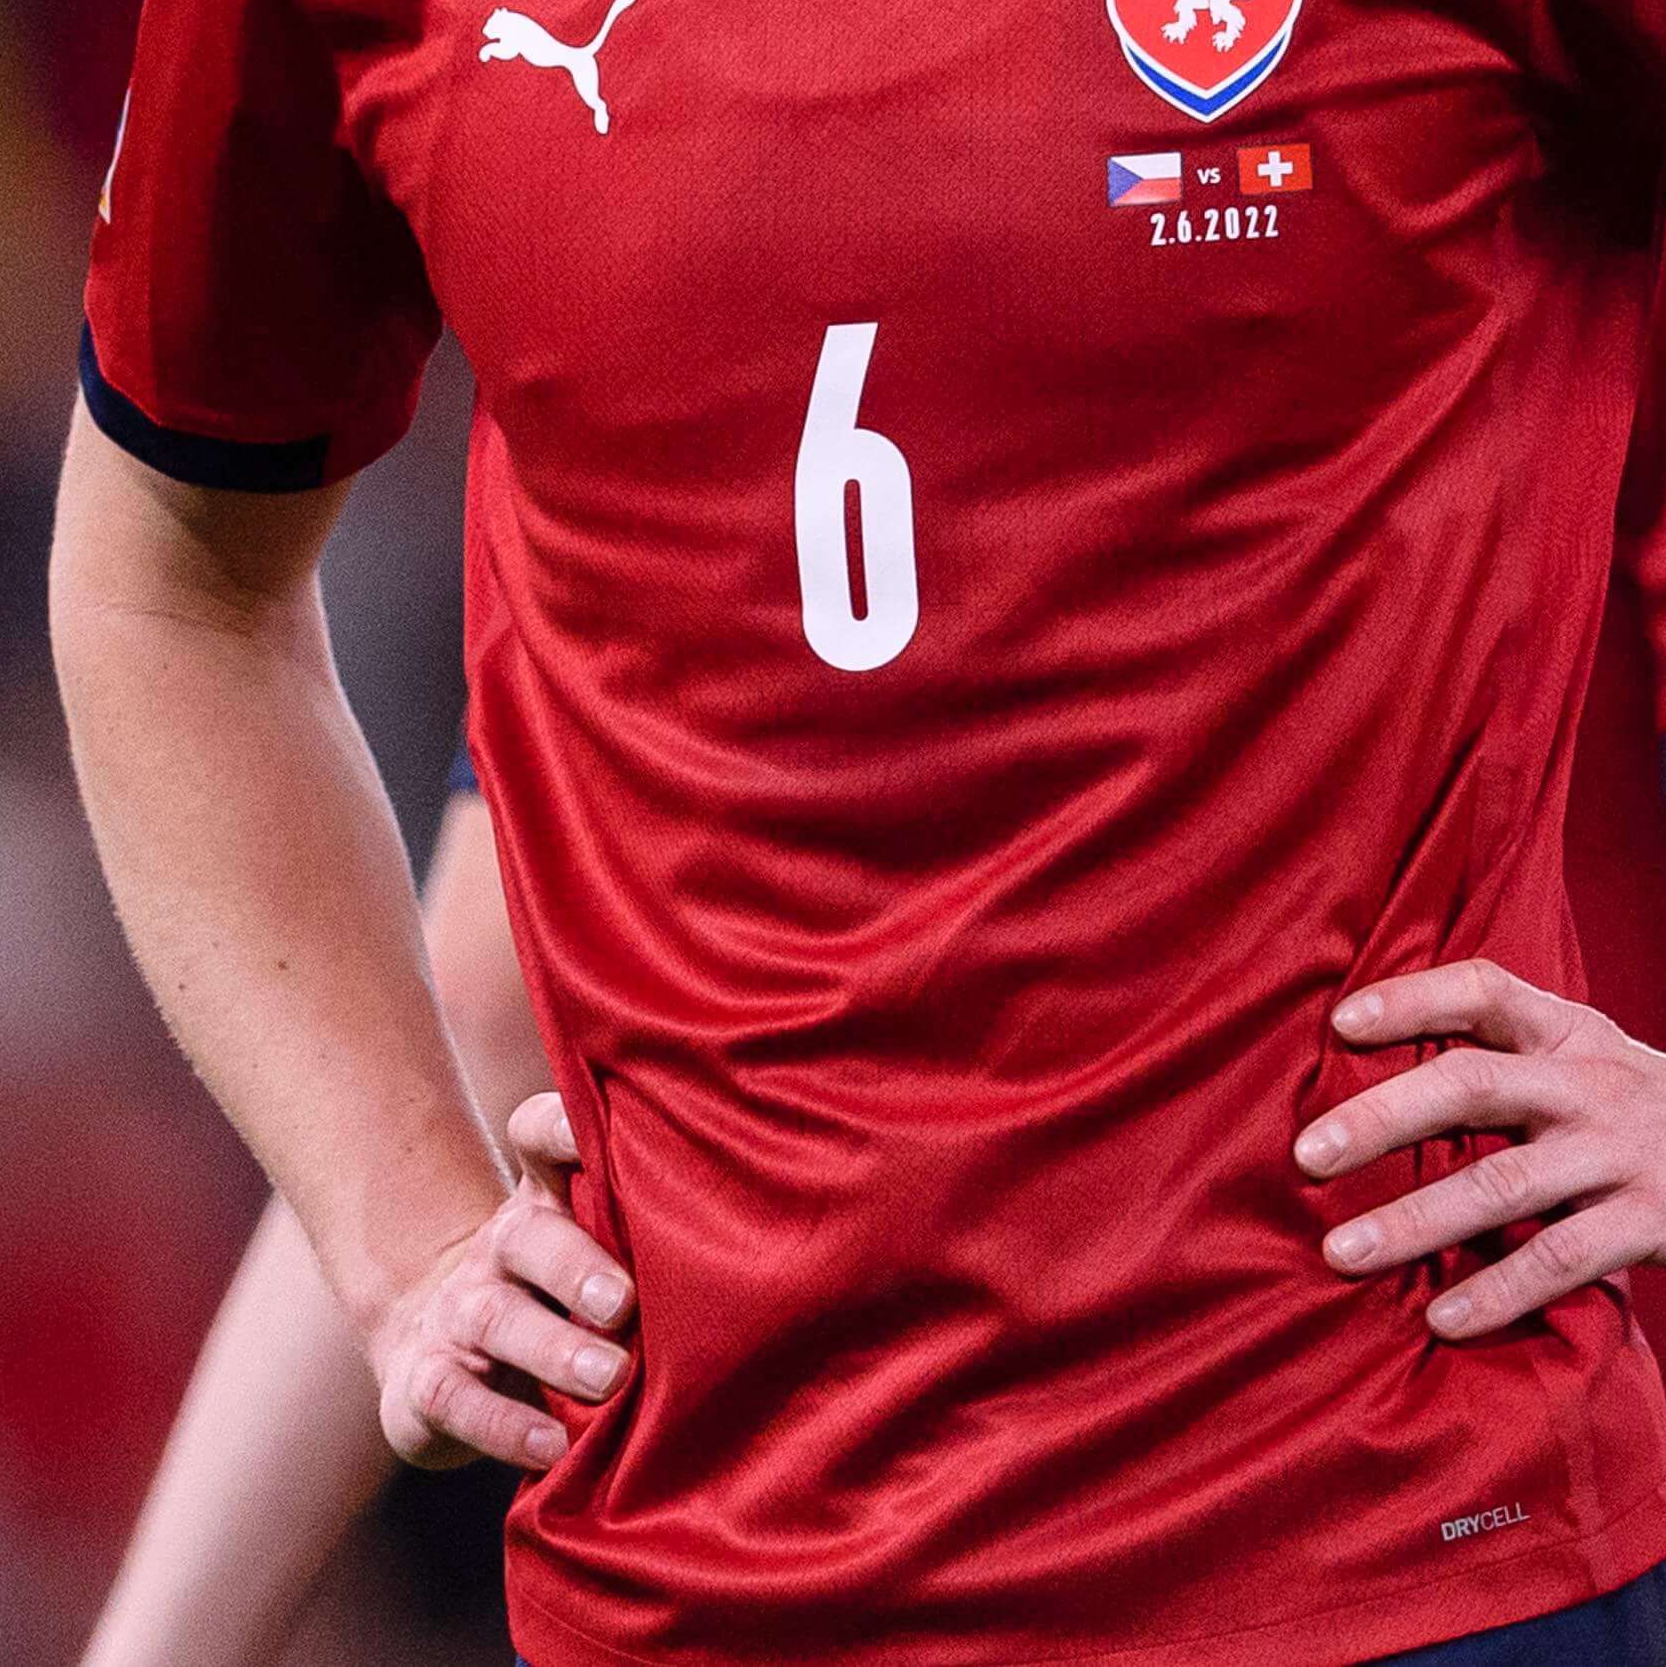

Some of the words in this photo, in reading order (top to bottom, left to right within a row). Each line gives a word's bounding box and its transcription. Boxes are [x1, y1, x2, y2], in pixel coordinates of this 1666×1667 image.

[1150, 205, 1280, 246] 2.6.2022
[795, 323, 918, 672] 6
[1441, 1502, 1531, 1541] DRYCELL
